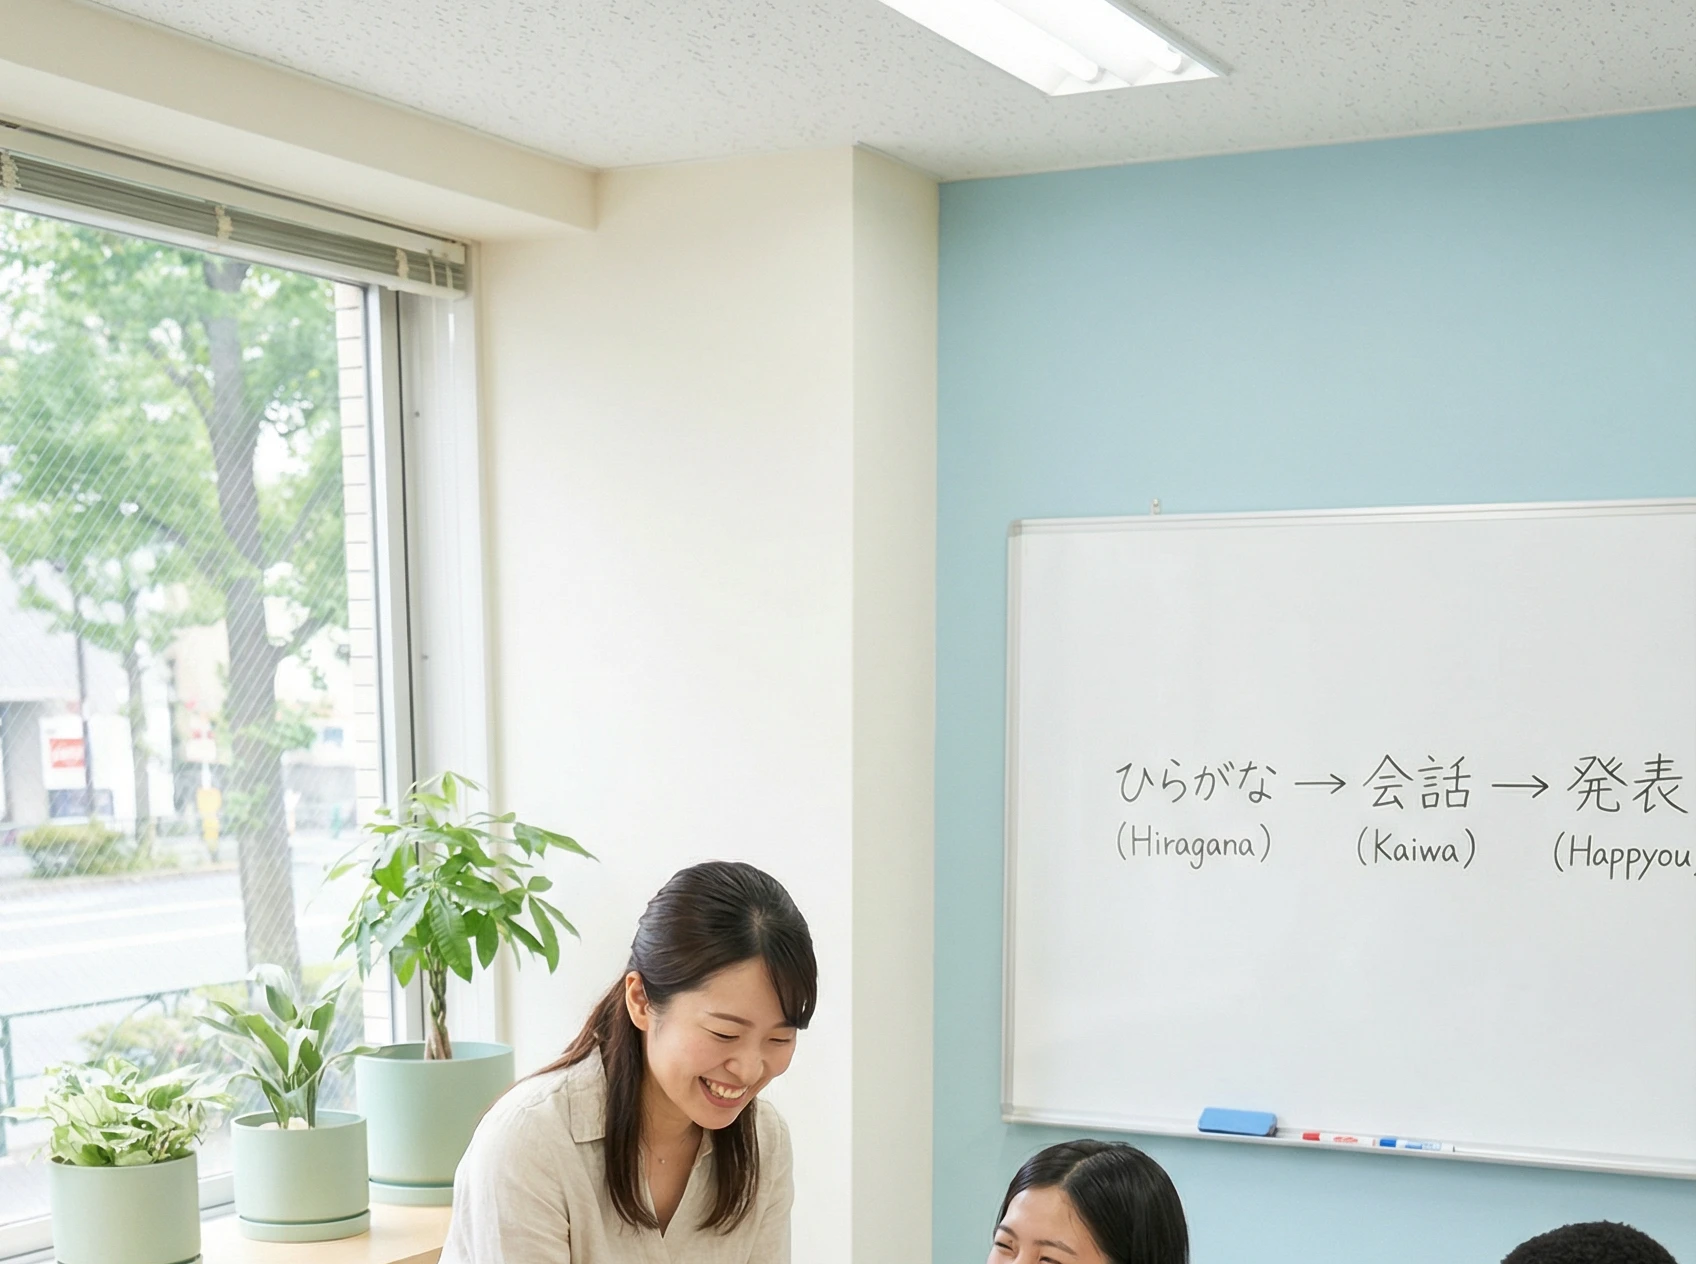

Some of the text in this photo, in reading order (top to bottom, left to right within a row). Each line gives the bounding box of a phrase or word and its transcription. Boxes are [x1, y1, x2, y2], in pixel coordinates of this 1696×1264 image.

[1115, 752, 1689, 814] ひらがな 会話 発表
[1116, 820, 1696, 882] (Hiragana) (Kaiwa) (Happyou
